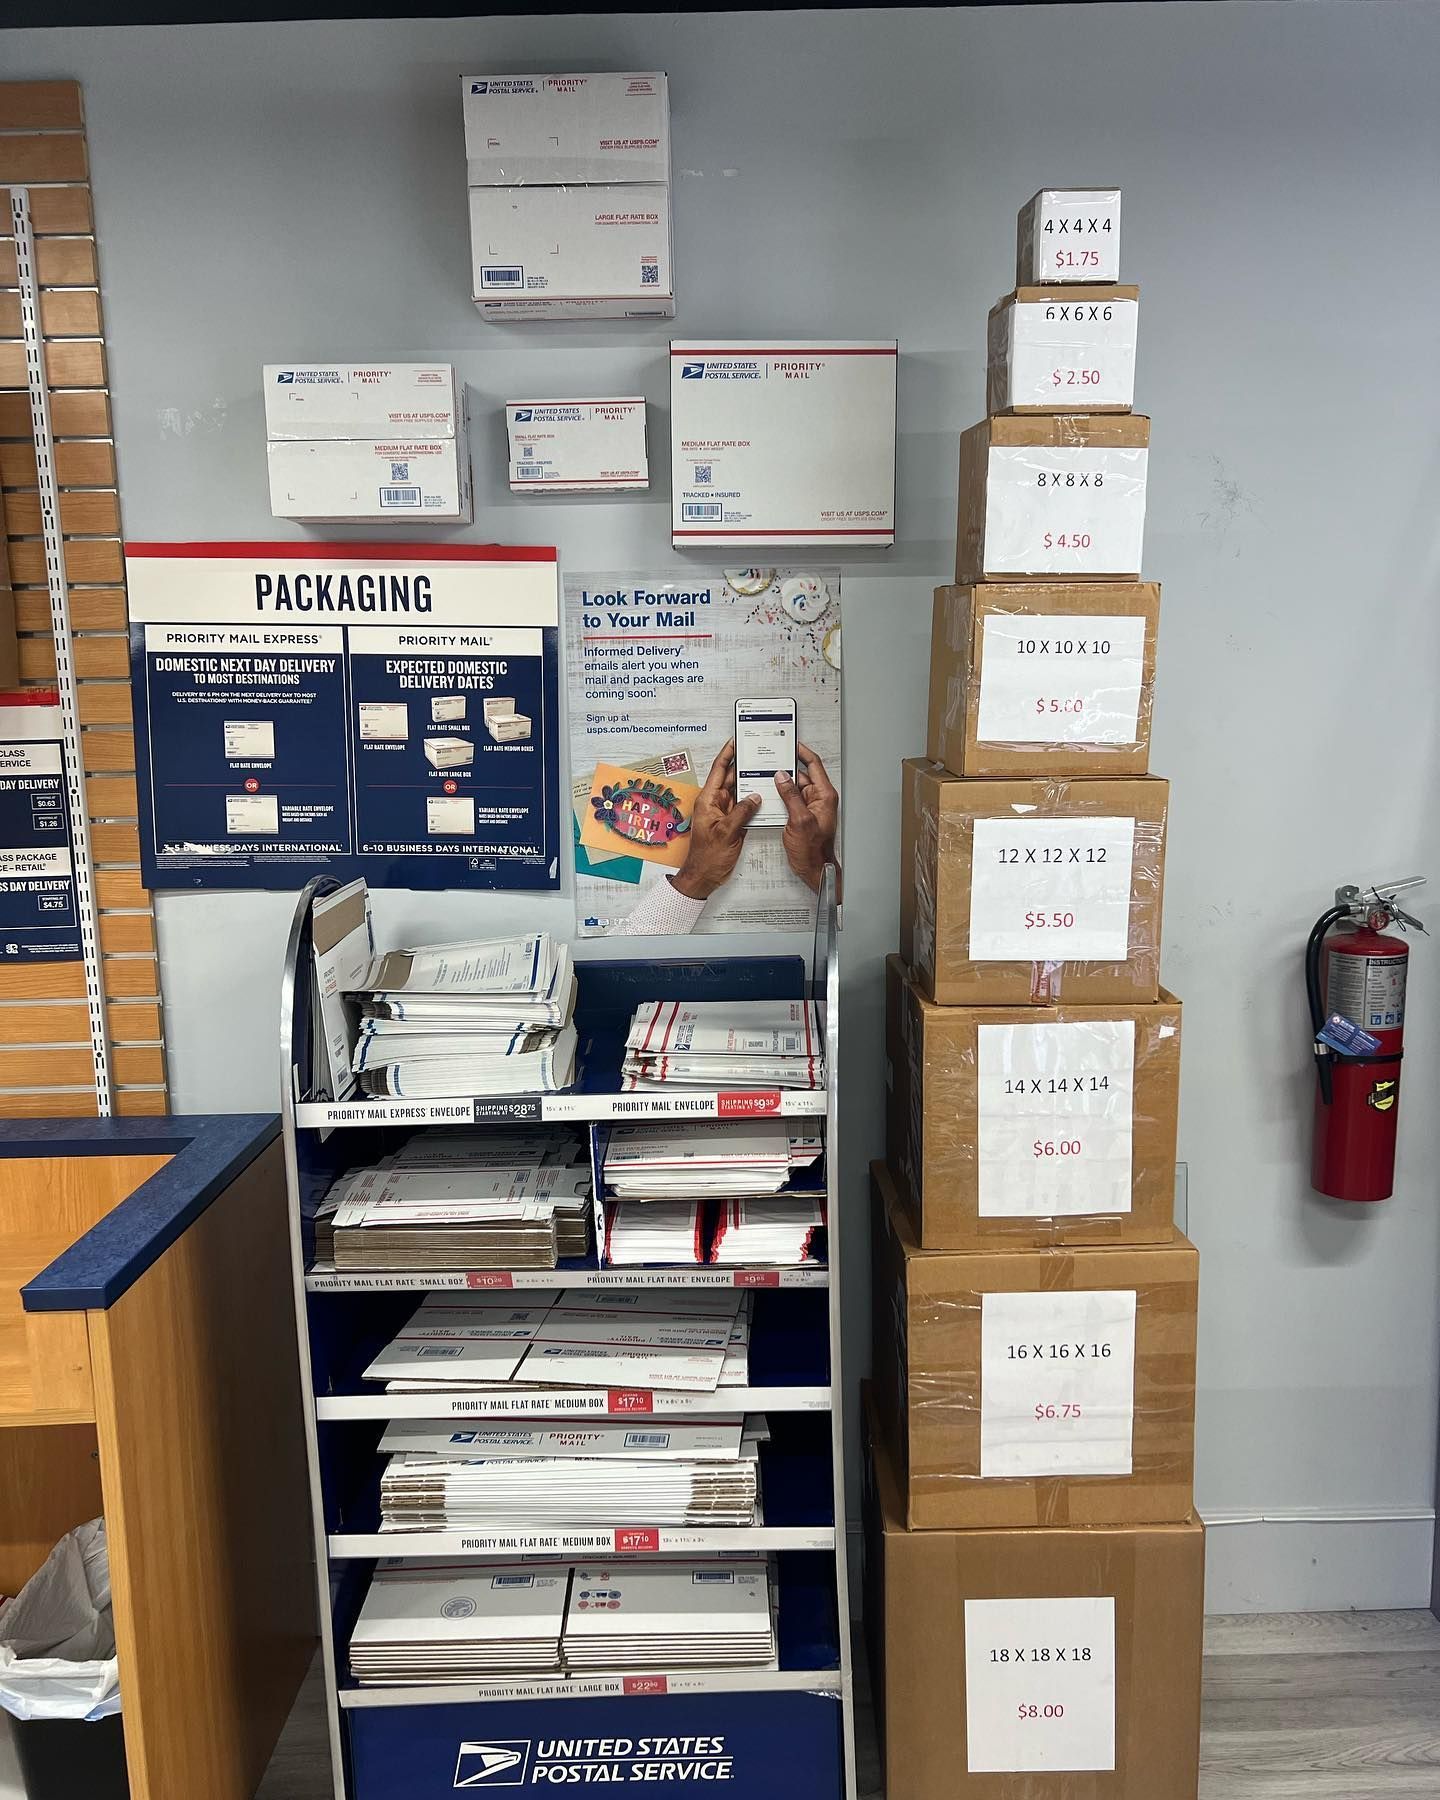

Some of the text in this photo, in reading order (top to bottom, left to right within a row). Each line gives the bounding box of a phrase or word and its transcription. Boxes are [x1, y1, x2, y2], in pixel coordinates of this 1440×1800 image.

[1044, 218, 1112, 234] 4 X 4 X 4
[1055, 250, 1099, 267] $1.75
[1060, 306, 1069, 320] X
[1074, 306, 1083, 320] 6
[1088, 306, 1098, 320] X
[1102, 306, 1112, 320] 6
[706, 362, 734, 370] UNITED
[704, 372, 730, 380] POSTAL
[1067, 370, 1100, 385] 2.50
[1038, 472, 1104, 488] 8 X 8 X 8
[1058, 534, 1090, 548] 4.50
[255, 574, 432, 612] PACKAGING
[582, 589, 711, 606] Look Forward
[583, 611, 695, 629] to Your Mail
[166, 633, 224, 644] PRIORITY
[229, 634, 260, 644] MAIL
[398, 636, 456, 646] PRIORITY
[584, 646, 634, 656] Informed
[1017, 640, 1110, 654] 10 X 10 X 10
[156, 658, 335, 673] DOMESTIC NEXT DAY DELIVERY
[386, 660, 508, 674] EXPECTED DOMESTIC
[584, 660, 699, 672] emails alert you when
[194, 674, 300, 684] TO MOST DESTINATIONS
[400, 675, 454, 688] DELIVERY
[585, 675, 606, 684] mail
[610, 674, 630, 684] and
[634, 674, 684, 686] packages
[586, 690, 624, 700] coming
[586, 714, 630, 724] Sign up at
[586, 724, 708, 734] usps.com/becomeinformed
[18, 778, 60, 790] DELIVERY
[38, 800, 56, 808] $0.63
[234, 844, 260, 852] DAYS
[386, 844, 432, 852] BUSINESS
[16, 854, 57, 862] PACKAGE
[998, 848, 1107, 864] 12 X 12 X 12
[10, 880, 70, 892] DAY DELIVERY
[1024, 911, 1074, 929] $5.50
[1005, 1076, 1110, 1094] 14 X 14 X 14
[328, 1110, 366, 1120] PRIORITY
[368, 1109, 388, 1119] MAIL
[430, 1106, 471, 1118] ENVELOPE
[612, 1102, 650, 1112] PRIORITY
[674, 1100, 714, 1110] ENVELOPE
[1033, 1140, 1082, 1157] $6.00
[1007, 1343, 1111, 1360] 16 X 16 X 16
[452, 1400, 487, 1411] PRIORITY
[490, 1400, 509, 1410] MAIL
[512, 1400, 529, 1410] FLAT
[554, 1398, 586, 1408] MEDIUM
[588, 1398, 604, 1408] BOX
[1034, 1403, 1082, 1420] $6.75
[990, 1648, 1092, 1662] 18 X 18 X 18
[478, 1688, 514, 1697] PRIORITY
[516, 1688, 534, 1696] MAIL
[536, 1686, 554, 1695] FLAT
[578, 1684, 602, 1694] LARGE
[604, 1683, 620, 1692] BOX
[1018, 1703, 1064, 1720] $8.00
[537, 1736, 724, 1758] UNITED STATES
[532, 1764, 625, 1784] POSTAL
